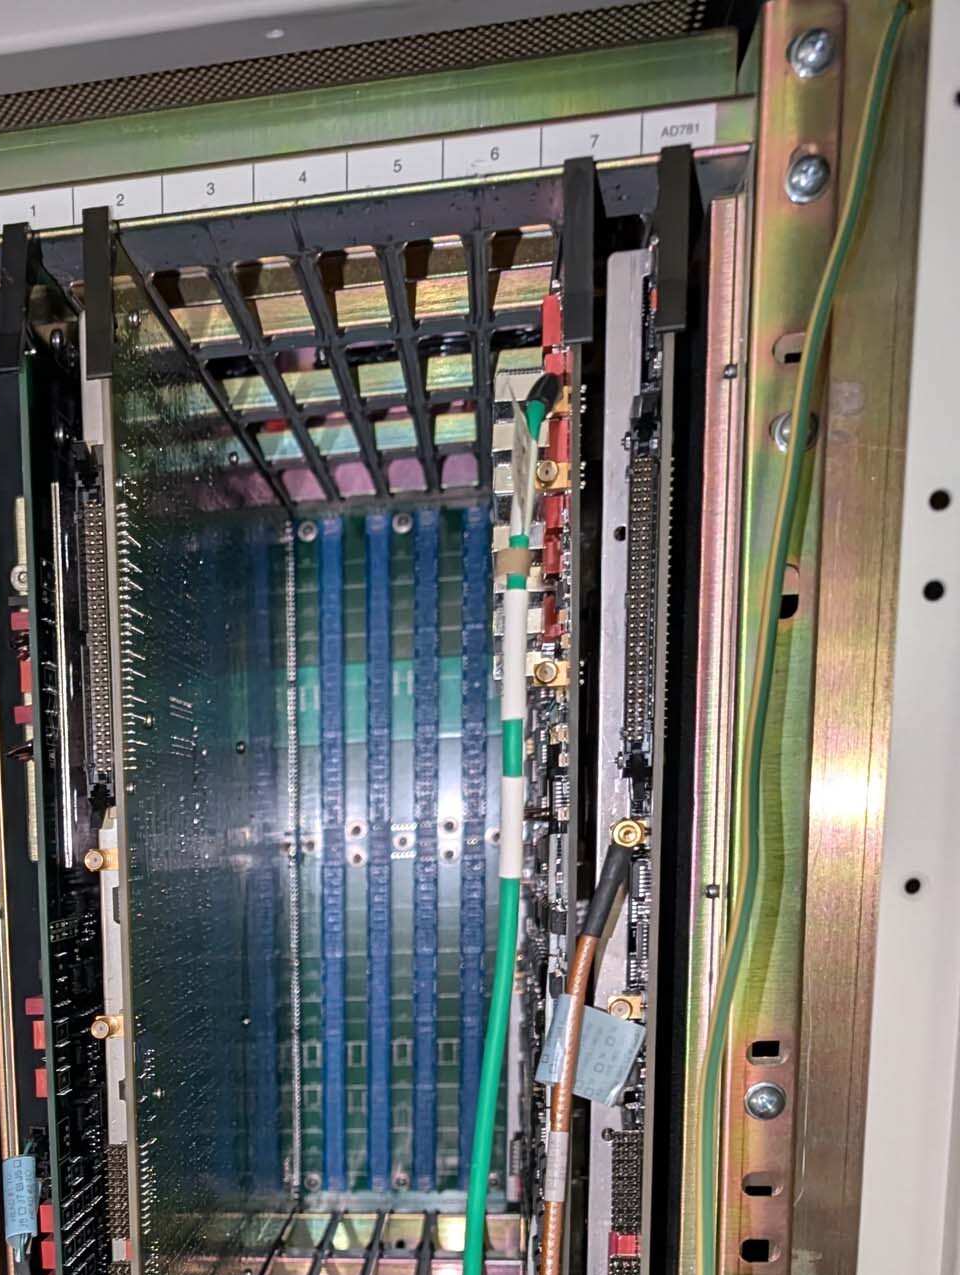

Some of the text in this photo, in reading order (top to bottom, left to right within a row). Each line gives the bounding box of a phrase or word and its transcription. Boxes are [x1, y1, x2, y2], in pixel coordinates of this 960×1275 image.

[660, 123, 700, 137] AD781
[590, 133, 600, 148] 7
[490, 146, 500, 161] 6
[393, 159, 403, 174] 5
[298, 171, 307, 184] 4
[206, 182, 216, 196] 3
[116, 193, 125, 207] 2
[29, 204, 36, 217] 1
